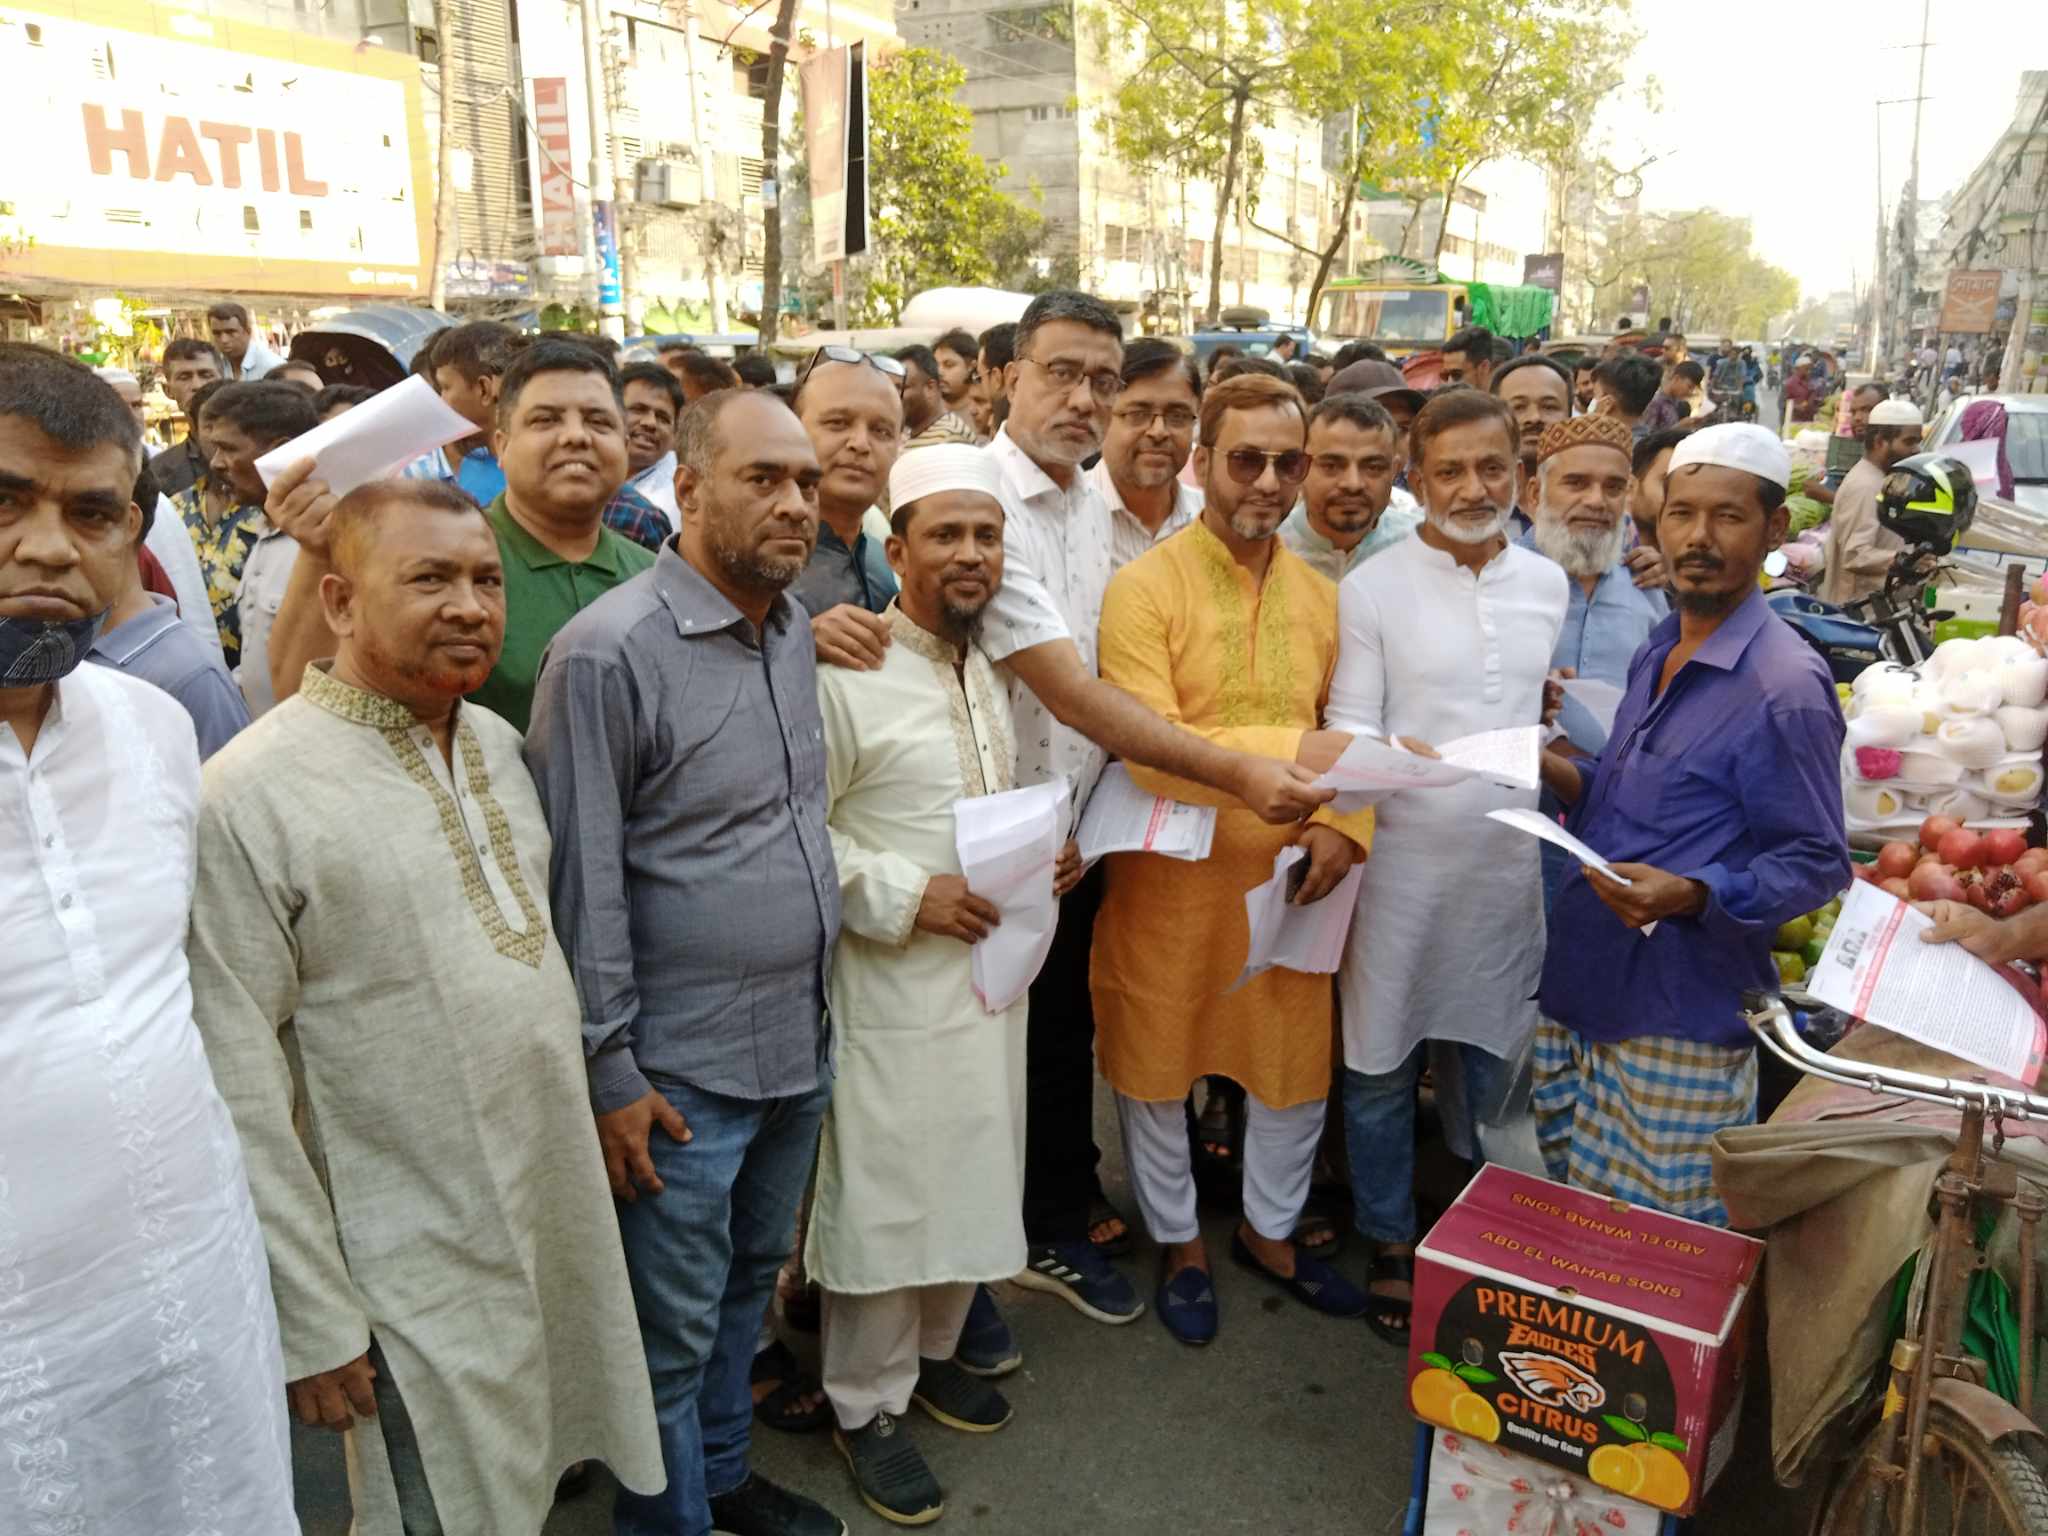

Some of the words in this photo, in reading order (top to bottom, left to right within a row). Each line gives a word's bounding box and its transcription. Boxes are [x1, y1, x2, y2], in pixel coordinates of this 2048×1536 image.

[82, 102, 328, 197] HATIL
[535, 83, 577, 249] HATIL
[1511, 1193, 1561, 1216] SONS
[1565, 1213, 1633, 1240] WAHAB
[1641, 1231, 1660, 1246] EL
[1664, 1239, 1706, 1255] ABD
[1480, 1231, 1521, 1251] ABD
[1523, 1246, 1546, 1261] EL
[1551, 1255, 1622, 1284] WAHAB
[1625, 1276, 1682, 1299] SONS
[1476, 1287, 1646, 1365] PREMIUM
[1496, 1392, 1599, 1444] CITRUS
[1506, 1421, 1541, 1443] Quality
[1541, 1433, 1561, 1449] Our
[1560, 1440, 1584, 1458] Goal
